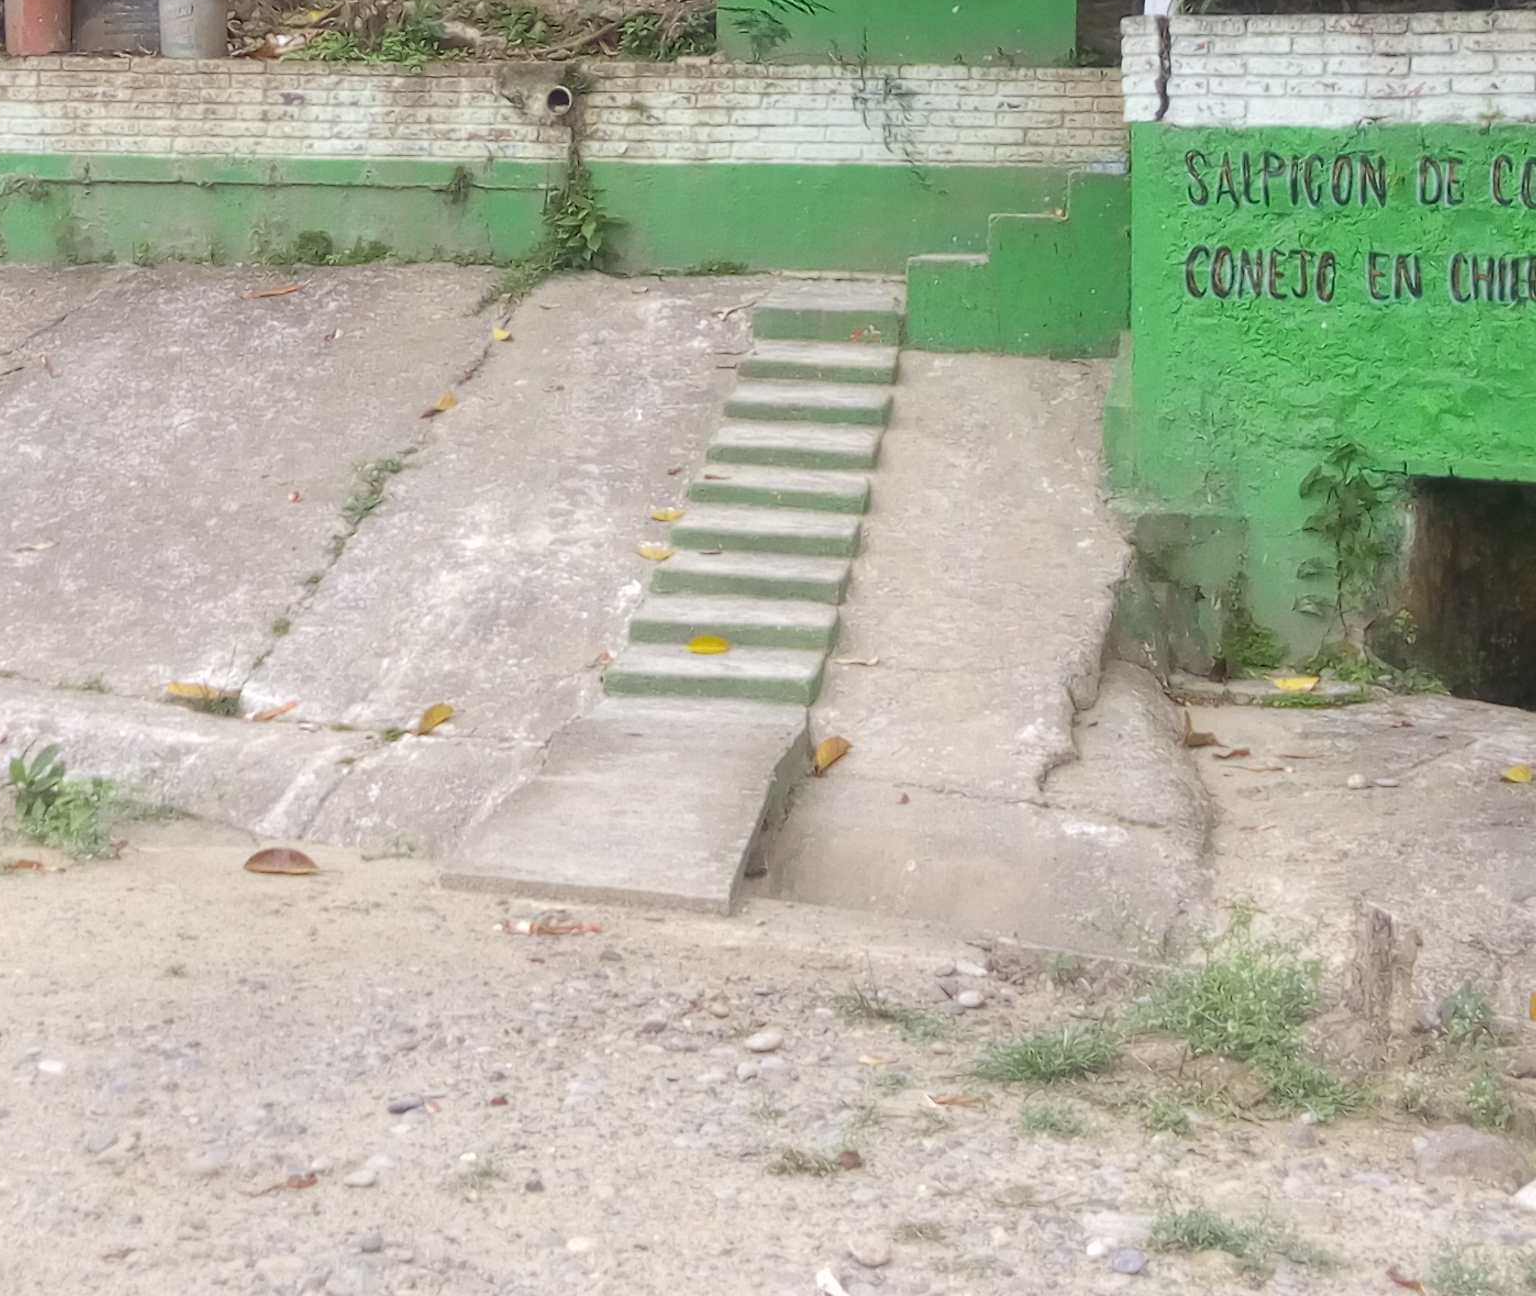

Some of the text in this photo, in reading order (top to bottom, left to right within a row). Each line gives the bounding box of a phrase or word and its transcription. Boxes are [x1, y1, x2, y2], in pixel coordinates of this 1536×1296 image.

[1185, 148, 1387, 207] SALPICON
[1417, 155, 1465, 206] DE
[1185, 244, 1337, 304] CONEJO
[1368, 251, 1423, 301] EN
